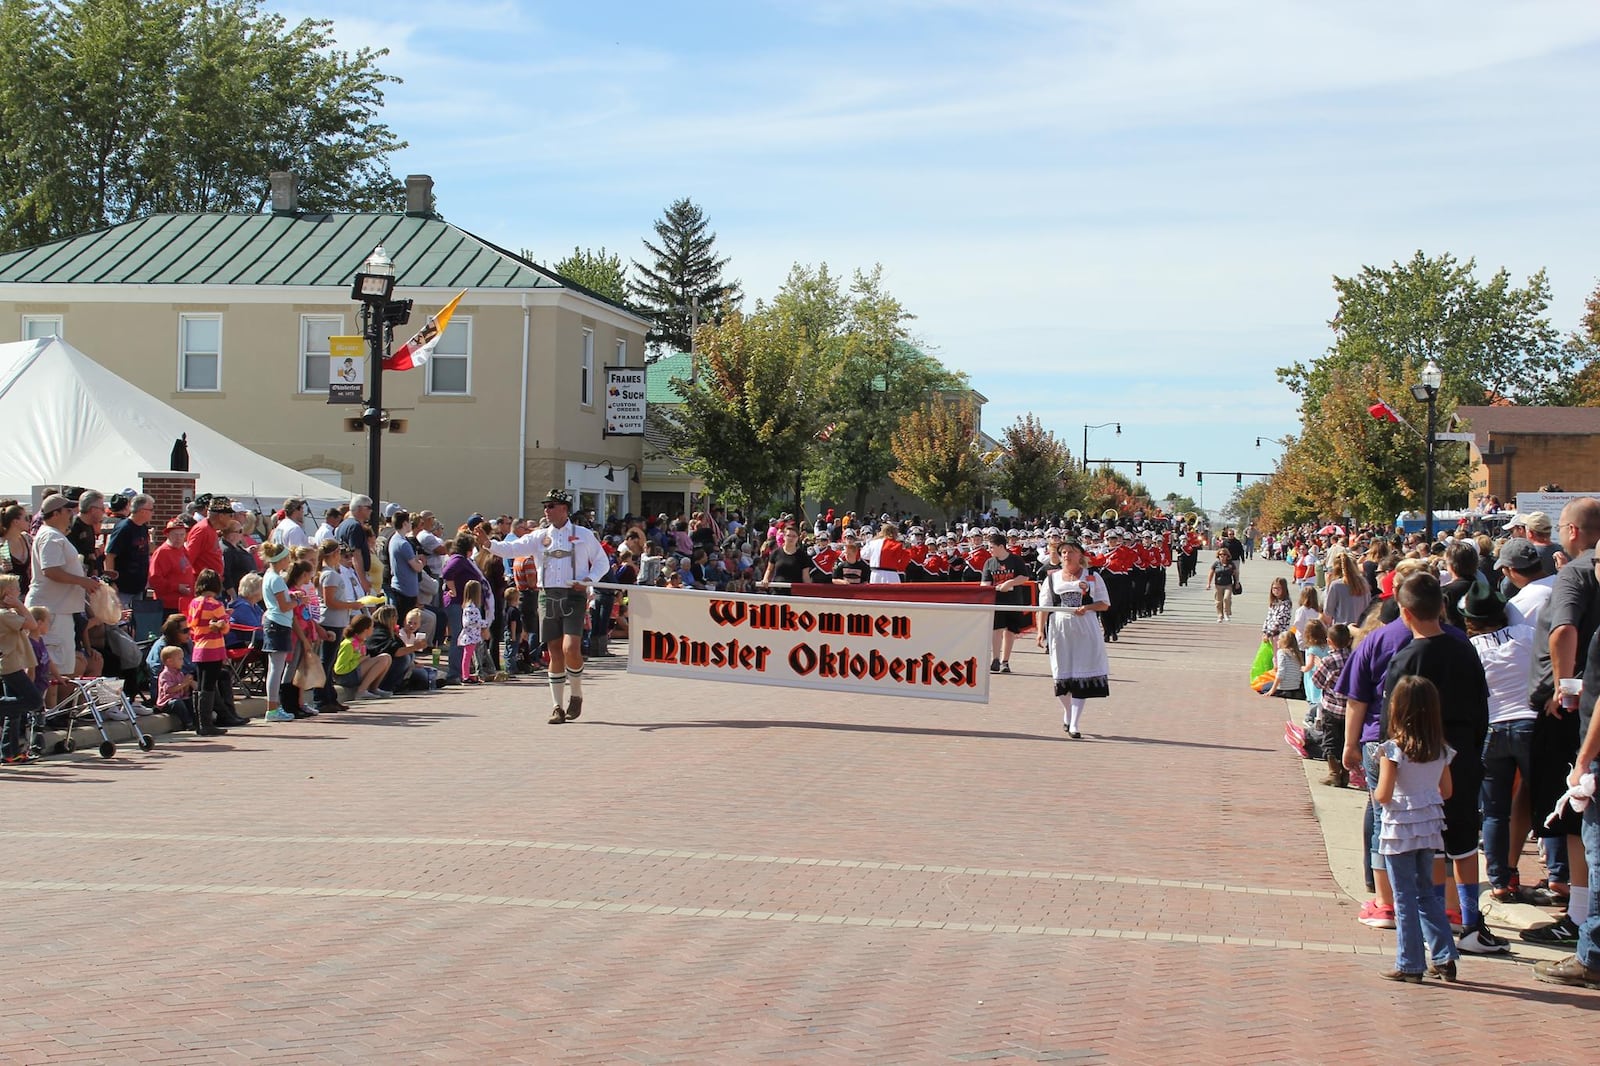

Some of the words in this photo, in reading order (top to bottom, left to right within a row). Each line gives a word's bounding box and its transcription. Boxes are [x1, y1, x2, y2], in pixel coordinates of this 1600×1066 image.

[611, 374, 641, 383] FRAMES
[622, 390, 644, 400] SUCH
[709, 599, 912, 639] Willkommen
[642, 629, 771, 673] Minster
[788, 641, 978, 688] Oktoberfest
